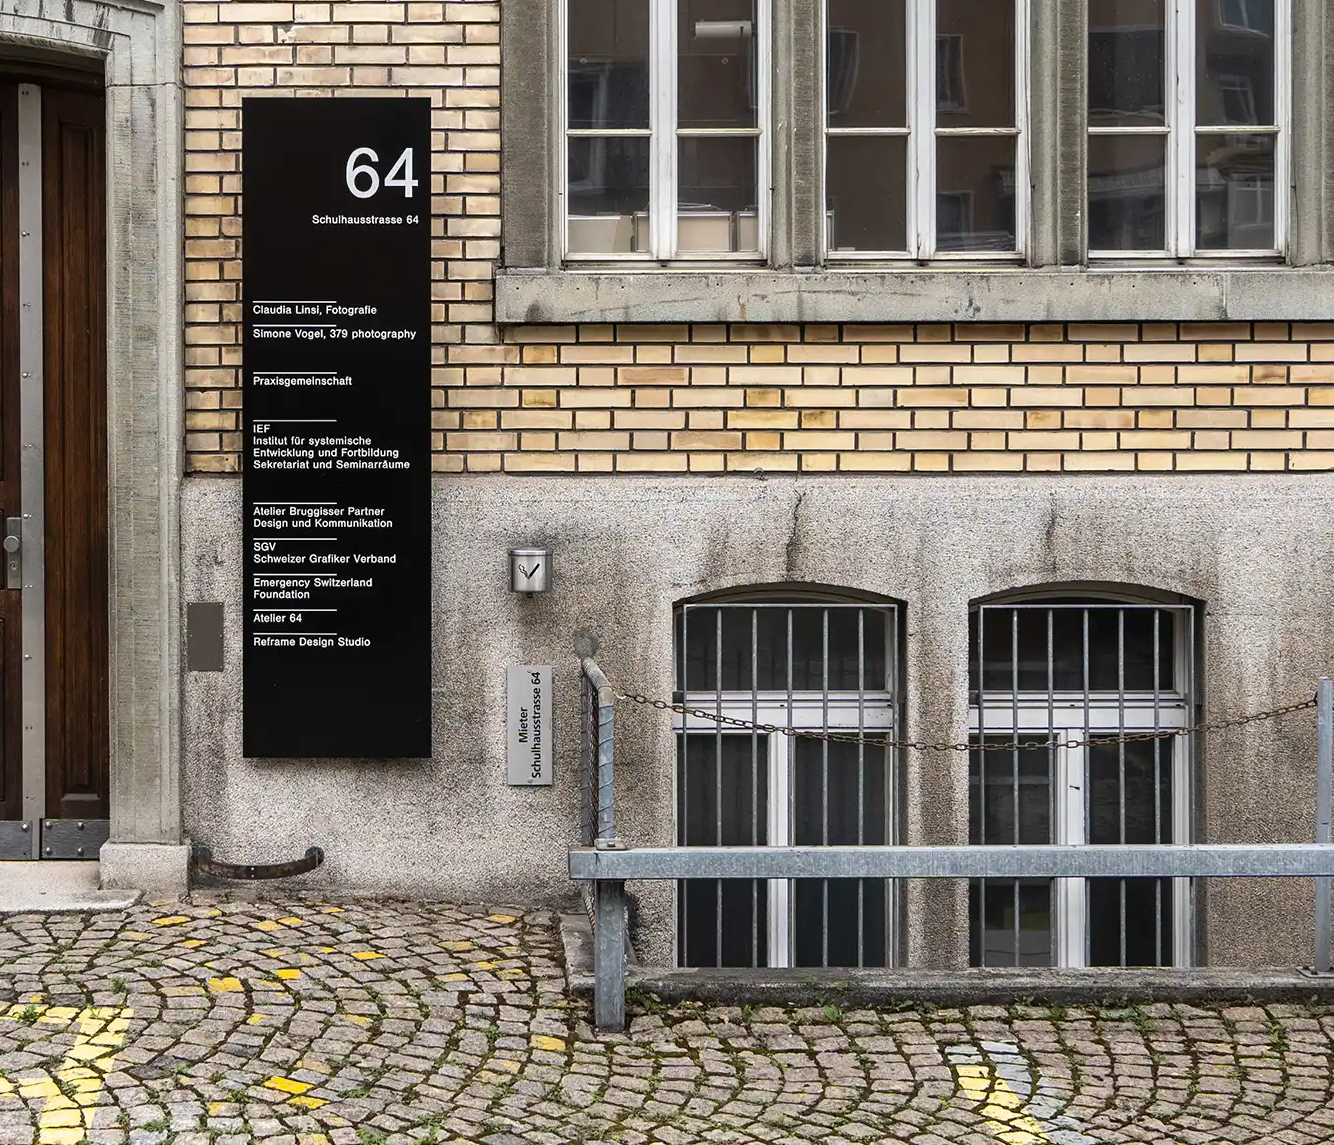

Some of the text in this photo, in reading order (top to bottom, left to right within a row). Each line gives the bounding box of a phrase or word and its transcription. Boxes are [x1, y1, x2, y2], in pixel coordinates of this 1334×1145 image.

[345, 146, 419, 199] 64
[311, 214, 420, 225] Schulhausstrasse 64
[252, 304, 292, 317] Claudia
[325, 304, 378, 317] Fotografie
[252, 328, 417, 341] Simone Vogel, 379 photography
[253, 375, 353, 388] Praxisgemeinschaft
[252, 423, 271, 434] IEF
[253, 435, 372, 448] Institut für systemische
[253, 447, 400, 459] Entwicklung und Fortbildung
[253, 459, 411, 470] Sekretariat und Seminarräume
[252, 506, 386, 518] Atelier Bruggisser Partner
[253, 518, 393, 530] Design und Kommunikation
[253, 541, 277, 552] SGV
[253, 553, 397, 564] Schweizer Grafiker Verband
[253, 577, 373, 589] Emergency Switzerland
[253, 589, 310, 600] Foundation
[252, 612, 303, 624] Atelier 64
[253, 636, 371, 649] Reframe Design Studio
[518, 707, 528, 743] Mieter
[531, 671, 541, 779] Schulhausstrasse 64
